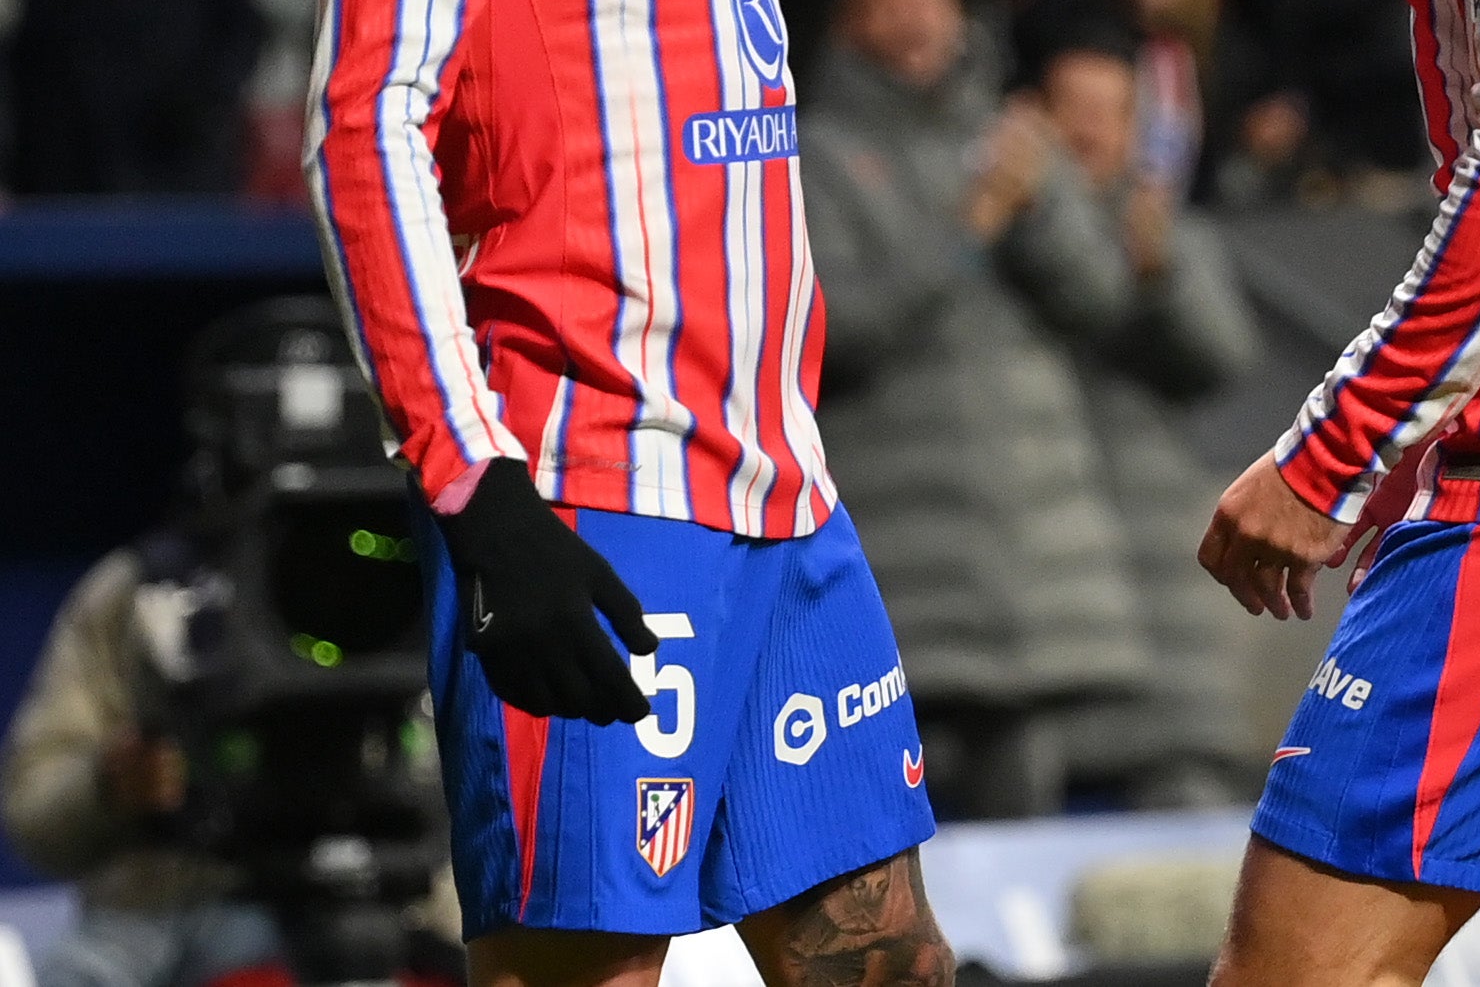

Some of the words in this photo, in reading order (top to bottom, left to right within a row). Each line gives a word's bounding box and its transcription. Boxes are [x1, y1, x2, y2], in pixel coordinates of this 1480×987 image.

[692, 112, 789, 160] RIYADH
[629, 612, 696, 759] 5
[837, 650, 908, 728] Com
[1308, 657, 1373, 710] Ave
